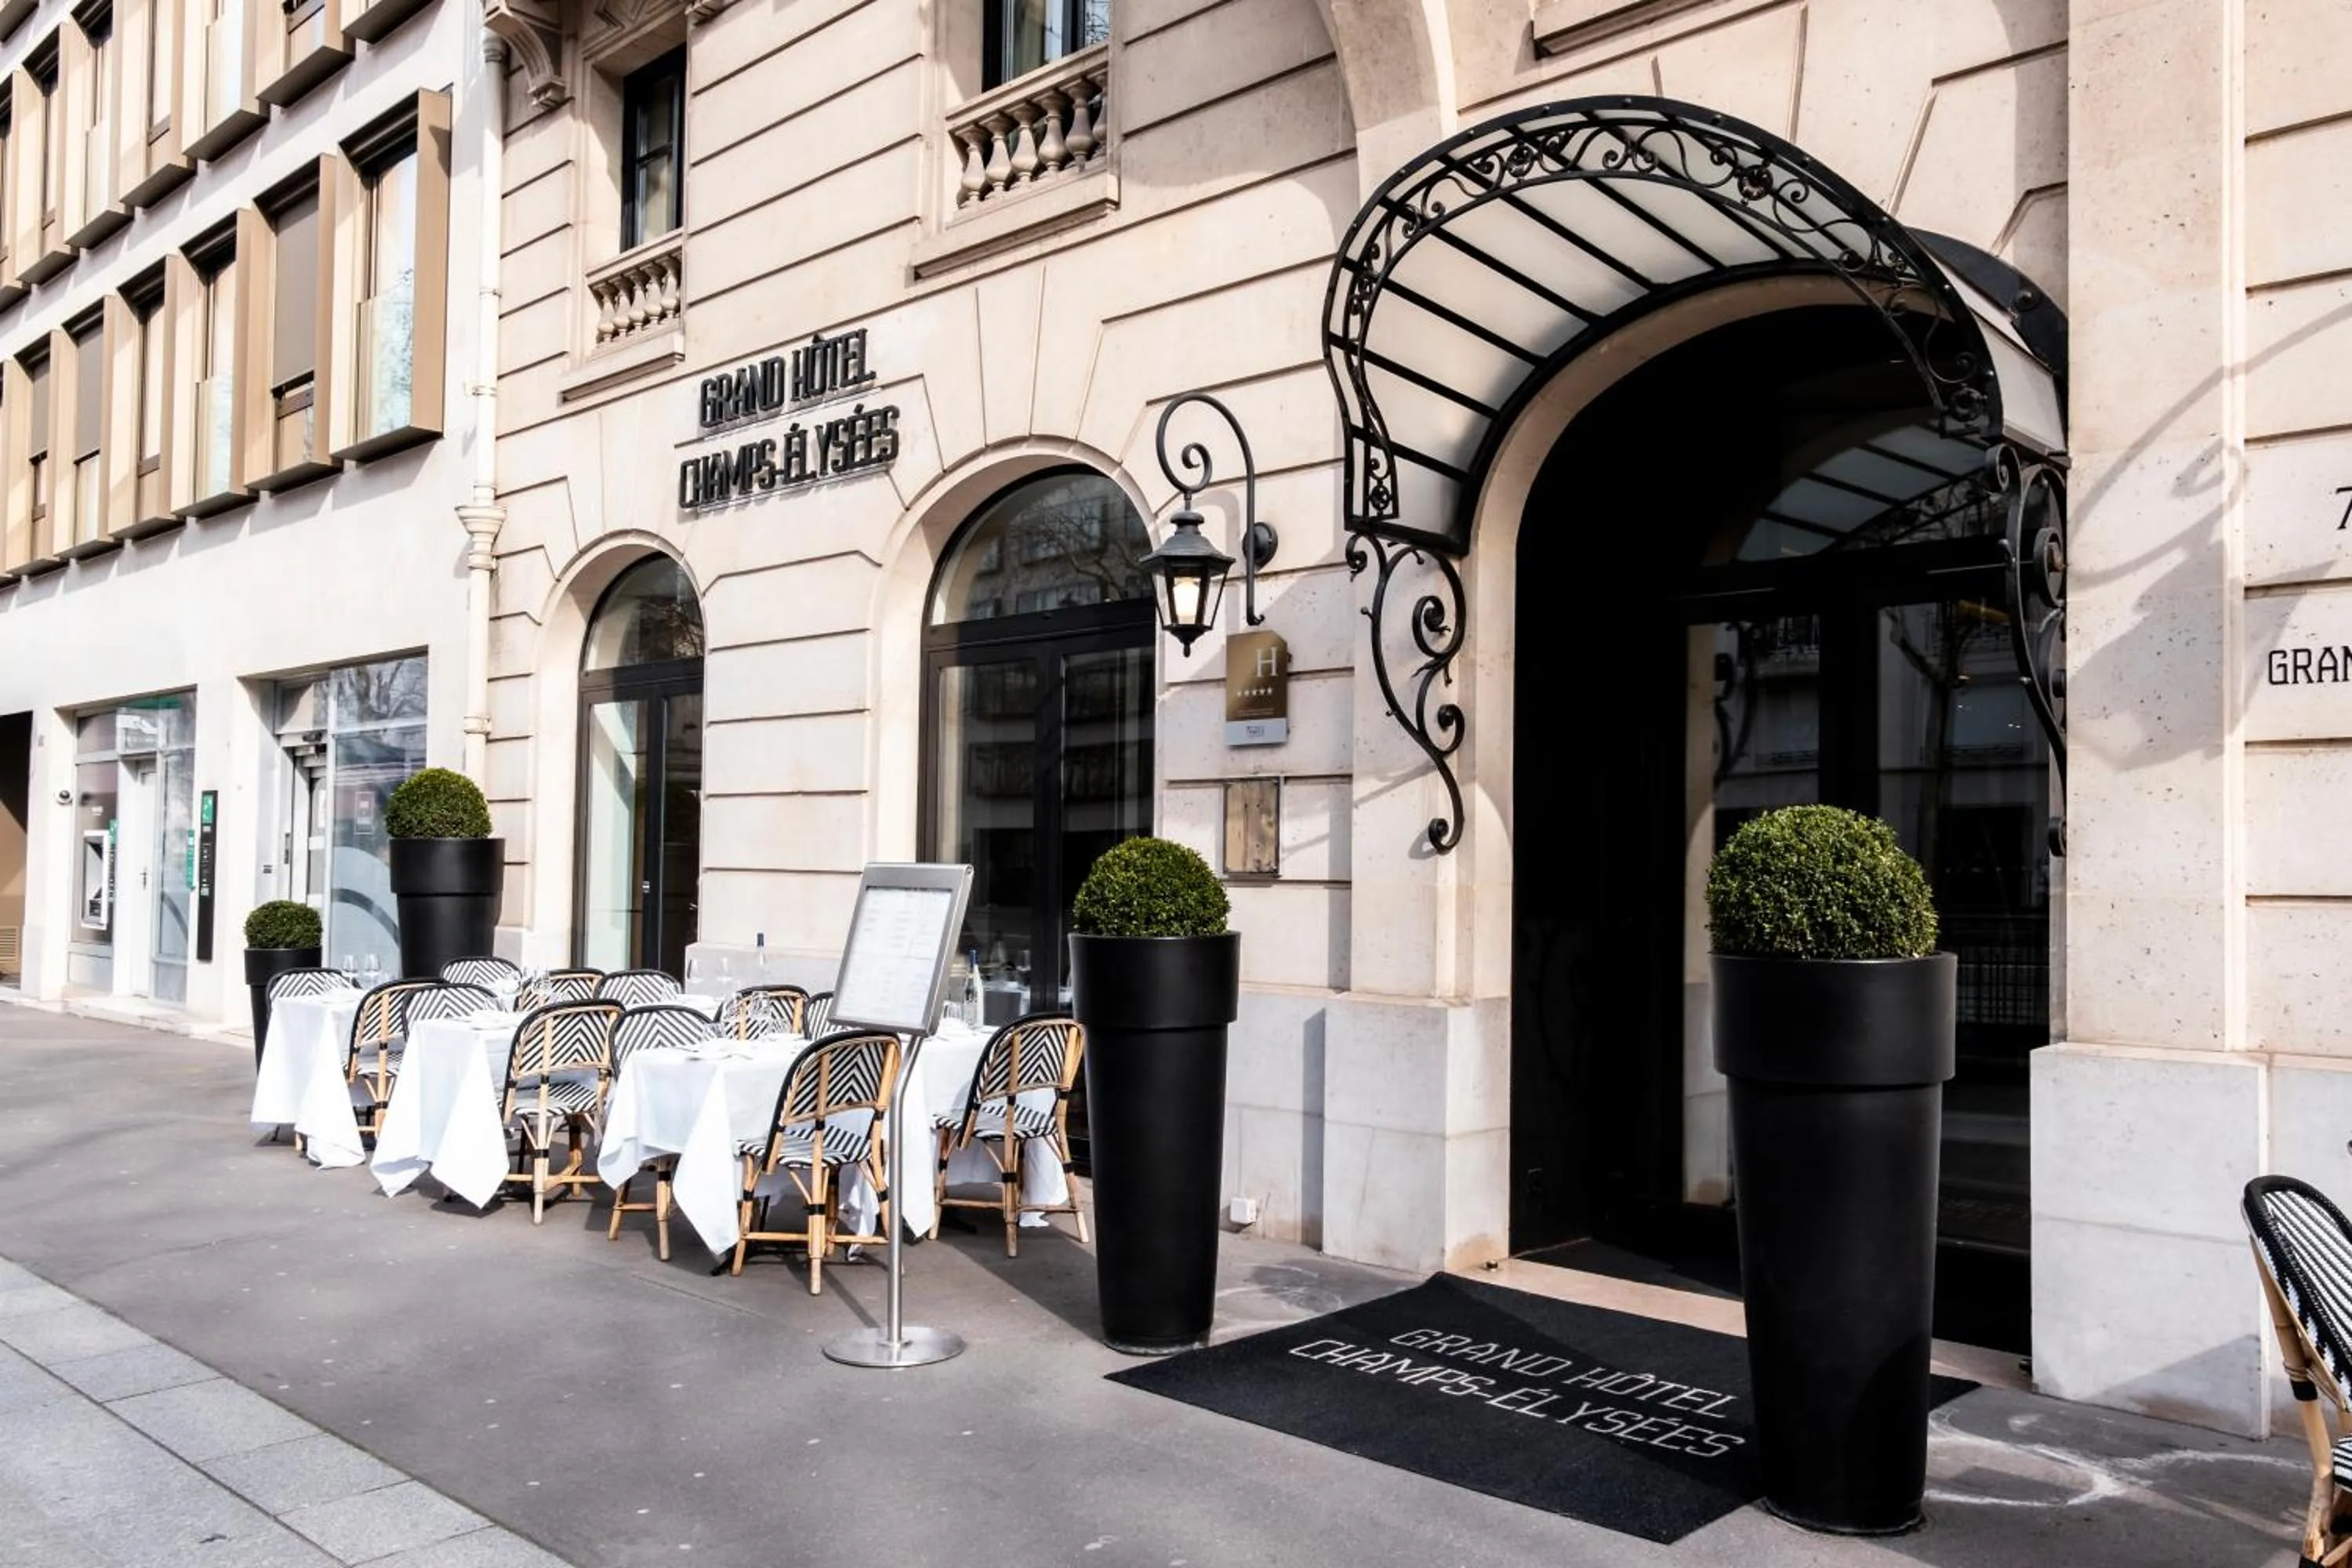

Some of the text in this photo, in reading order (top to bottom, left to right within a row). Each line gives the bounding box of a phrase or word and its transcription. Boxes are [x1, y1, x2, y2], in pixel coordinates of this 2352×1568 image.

[700, 327, 877, 428] GRAND HÔTEL
[678, 402, 901, 509] CHAMPS-ÉLYSÉES
[1255, 646, 1279, 678] H
[1389, 1328, 1738, 1418] GRAND HÔTEL
